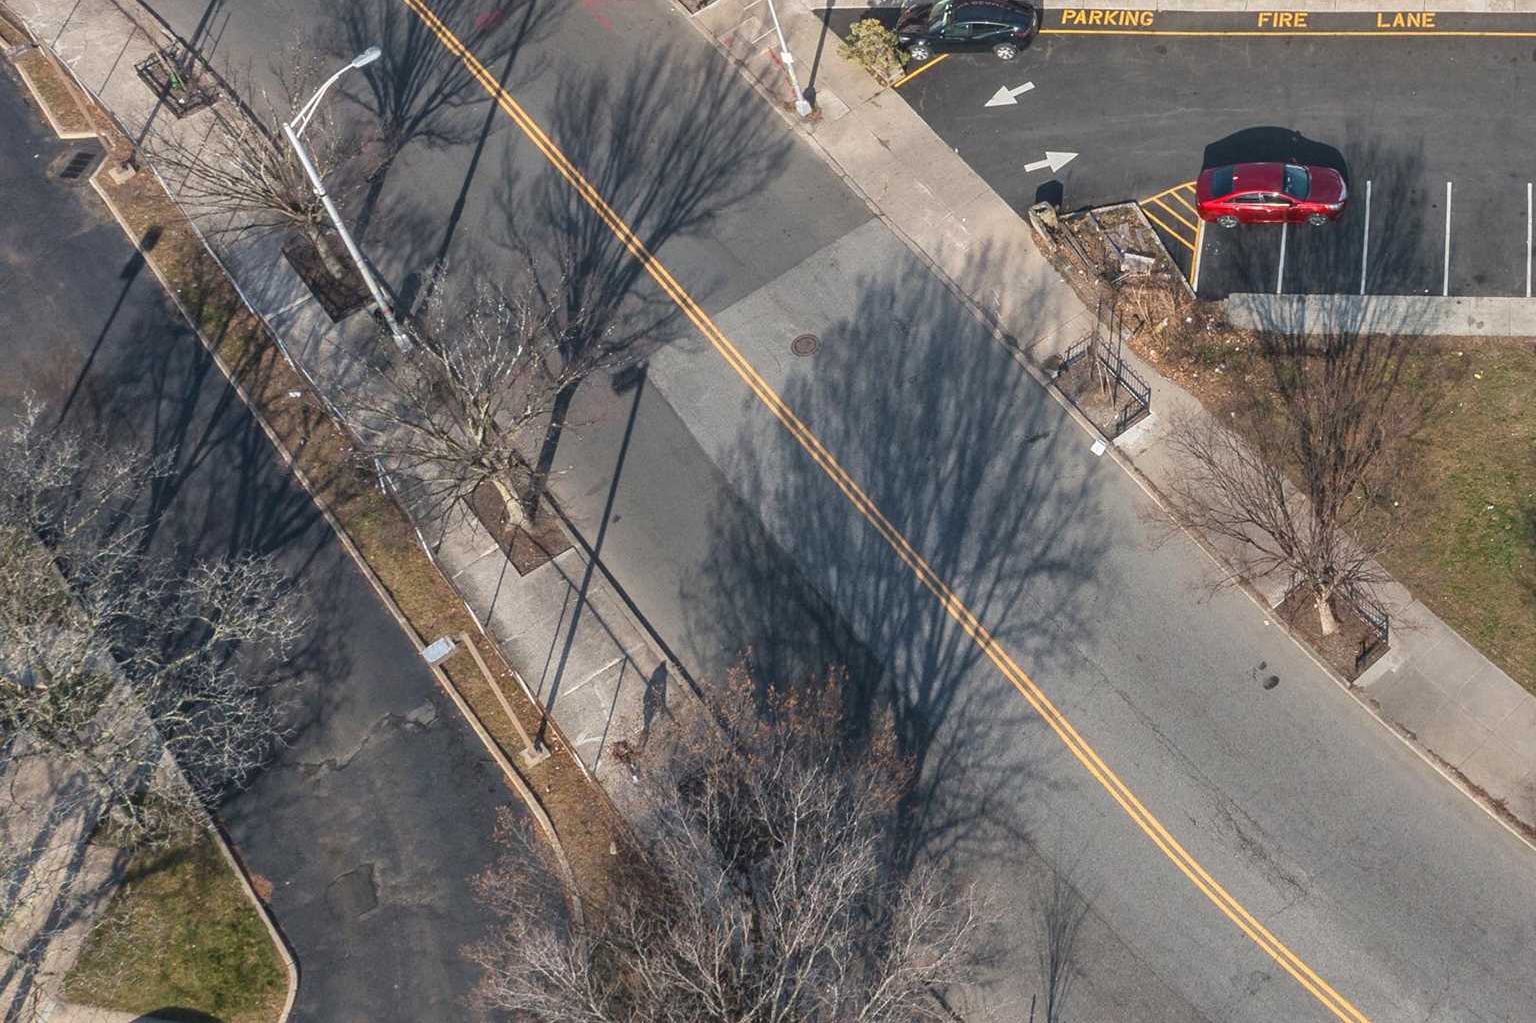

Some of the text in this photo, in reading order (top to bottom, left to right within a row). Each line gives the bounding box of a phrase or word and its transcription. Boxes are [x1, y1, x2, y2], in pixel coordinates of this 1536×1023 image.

[1061, 8, 1154, 26] PARKING
[1258, 11, 1309, 27] FIRE
[1377, 11, 1436, 28] LANE
